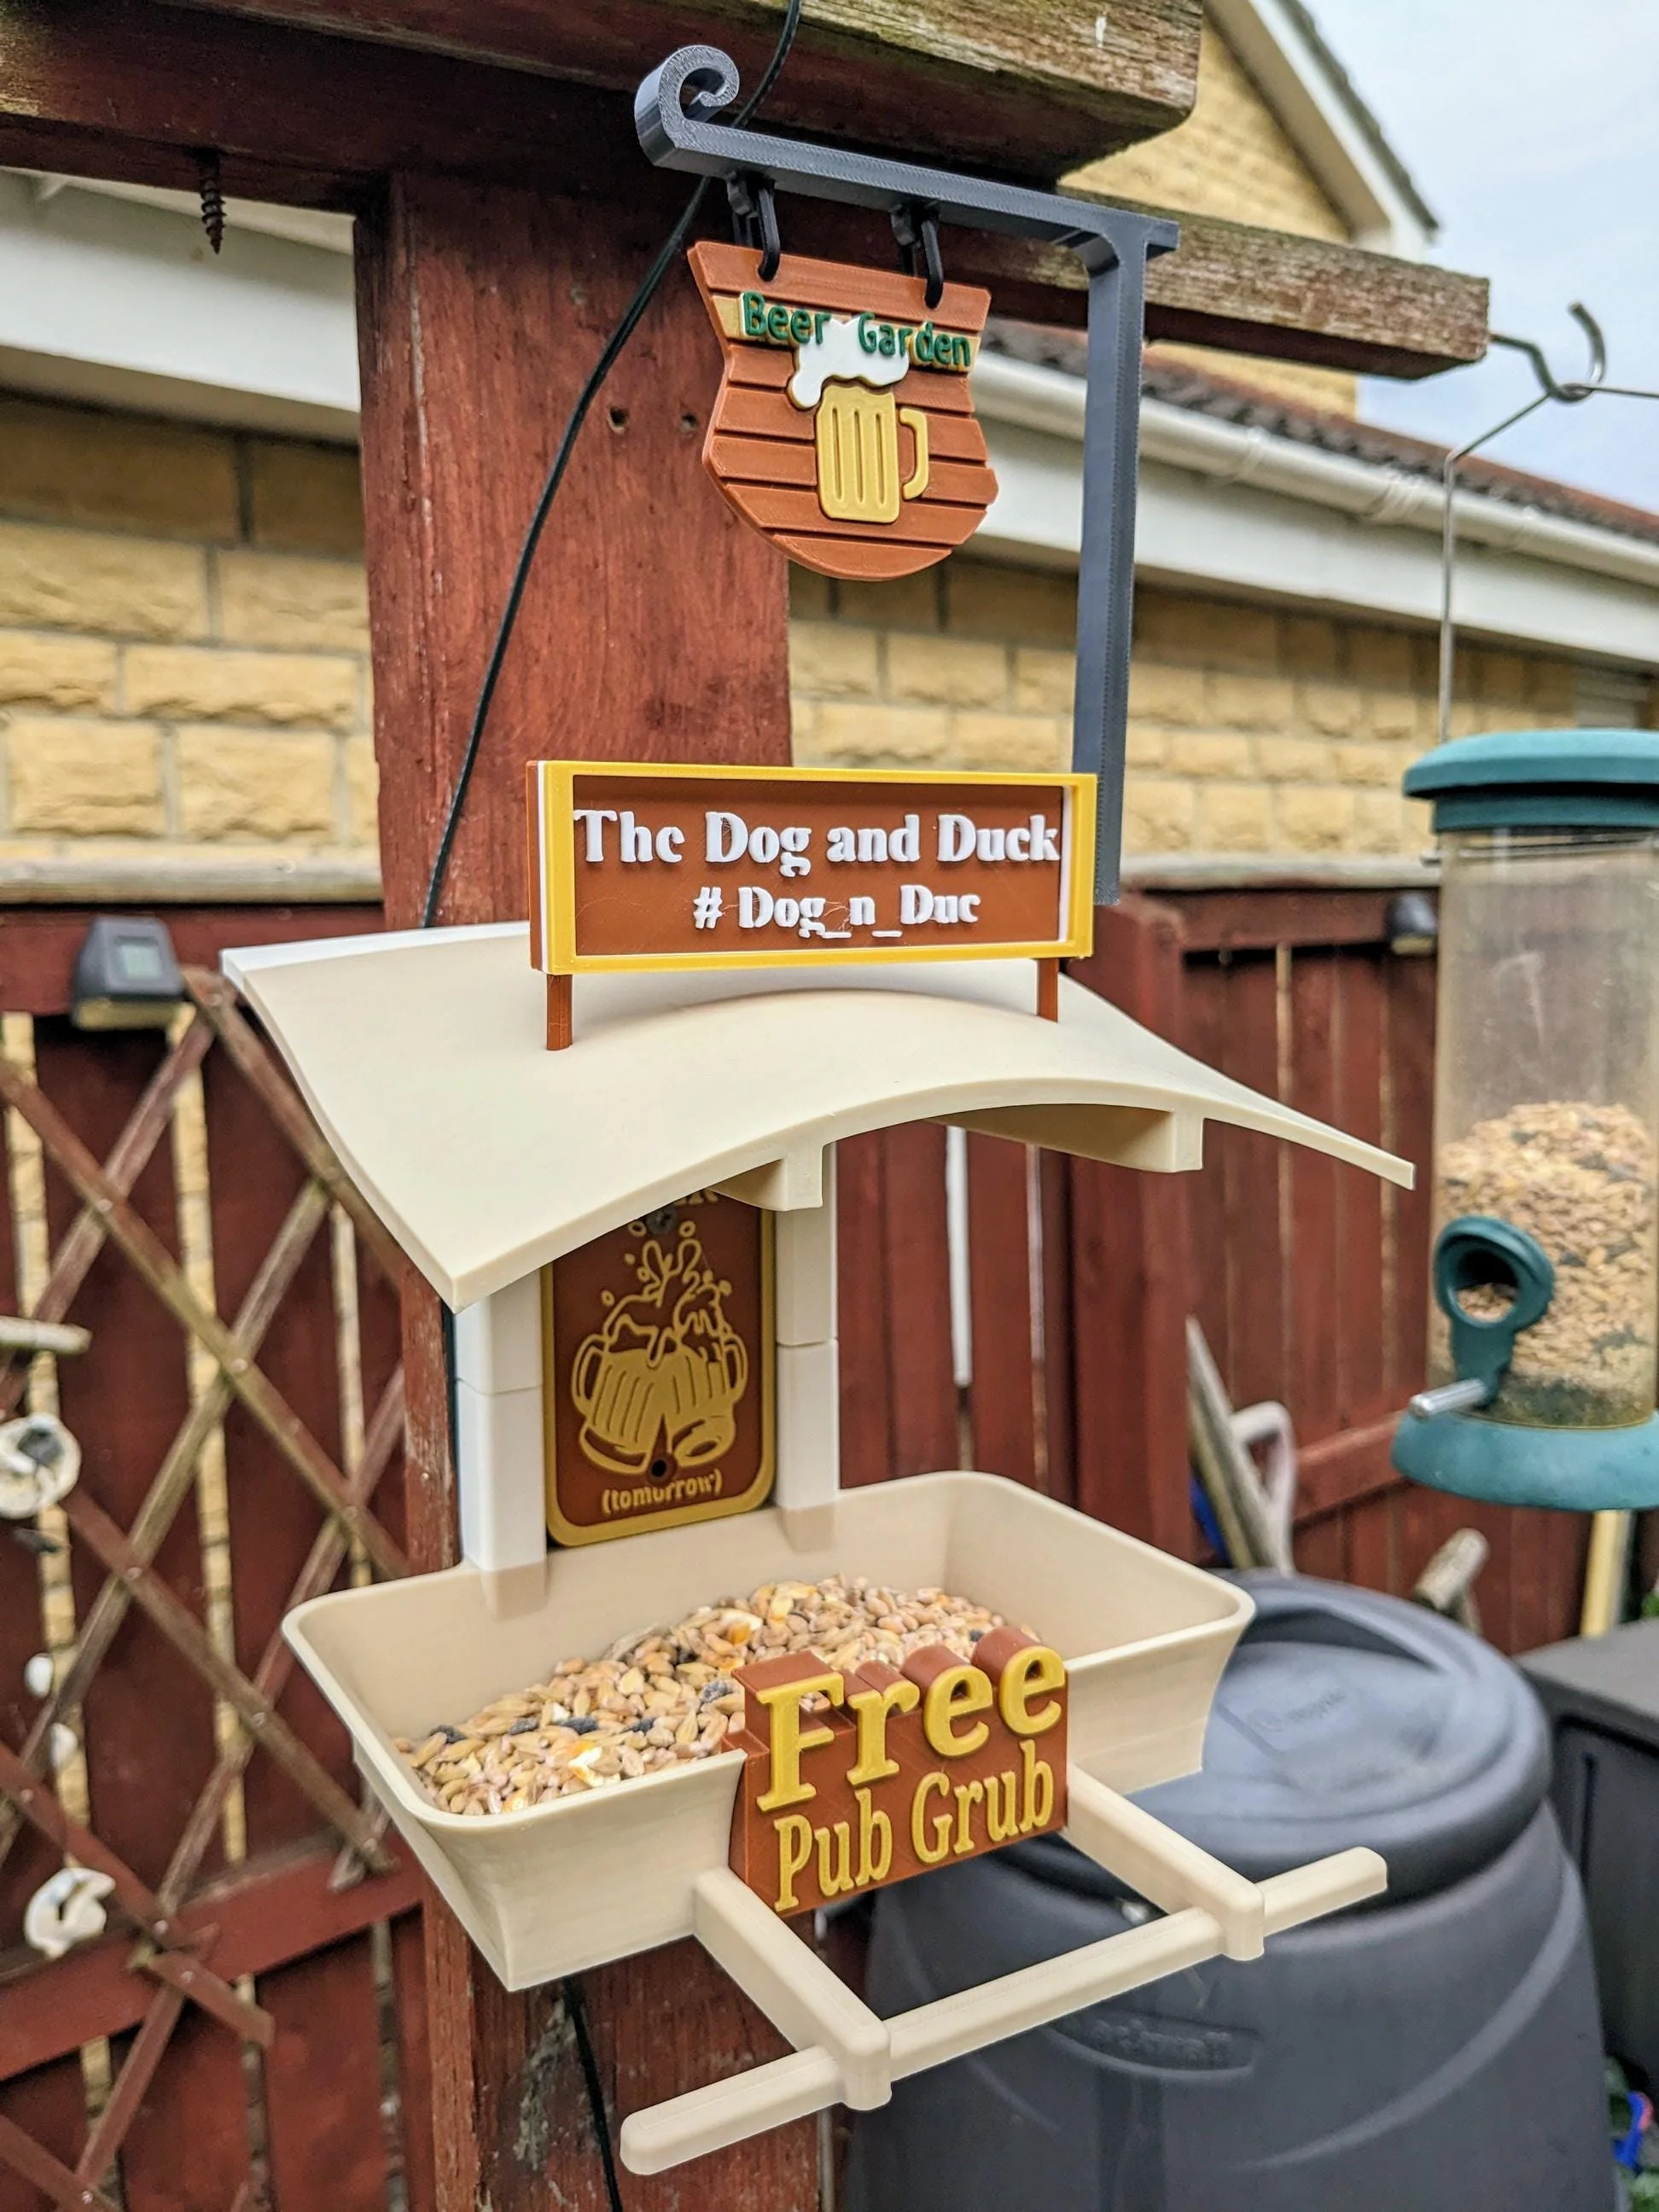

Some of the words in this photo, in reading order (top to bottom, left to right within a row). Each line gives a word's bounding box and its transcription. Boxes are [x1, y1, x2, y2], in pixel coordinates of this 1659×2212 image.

[741, 291, 831, 345] Beer
[858, 311, 971, 368] Garden
[705, 812, 812, 877] Dog
[826, 814, 921, 862] and
[937, 814, 1061, 862] Duck
[755, 1645, 1066, 1813] Free
[773, 1788, 894, 1913] Pub
[911, 1738, 1055, 1865] Grub
